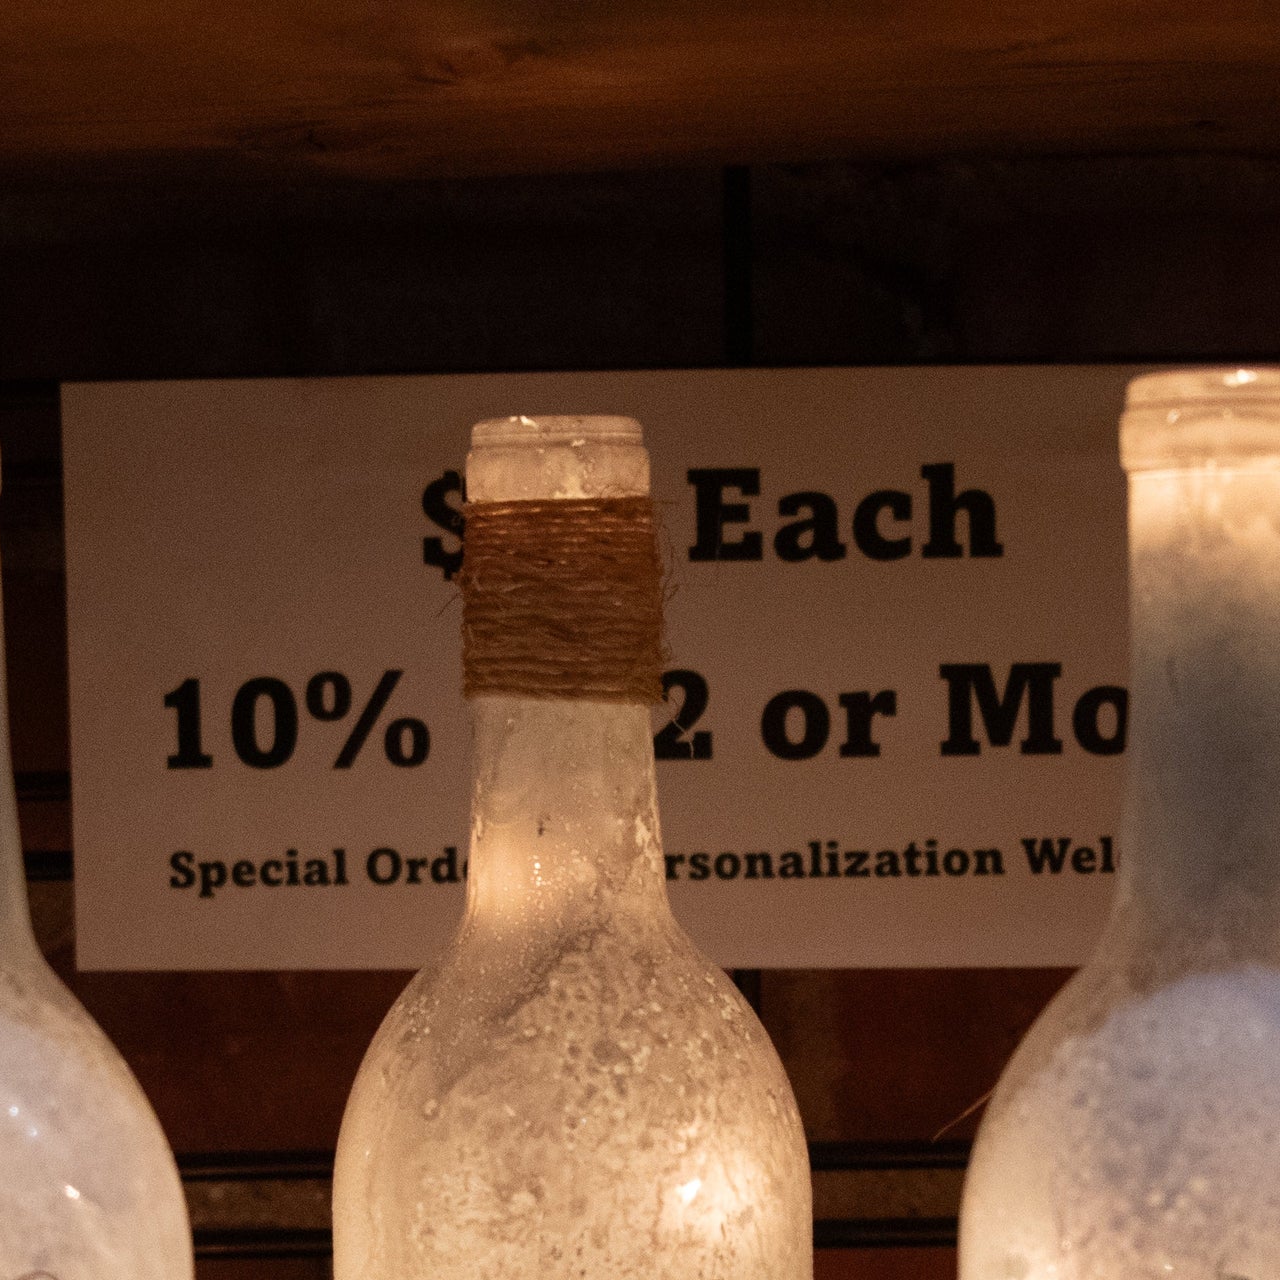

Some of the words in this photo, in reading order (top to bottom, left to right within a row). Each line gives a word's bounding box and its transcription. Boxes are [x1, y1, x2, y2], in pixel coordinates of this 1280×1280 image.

[687, 463, 1003, 562] Each
[162, 669, 430, 770] 10%
[653, 669, 714, 760] 2
[760, 689, 898, 760] or
[940, 662, 1130, 756] Mo
[170, 849, 349, 899] Special
[367, 846, 468, 885] Ord
[664, 839, 1006, 881] rsonalization
[1021, 836, 1116, 876] Wel
